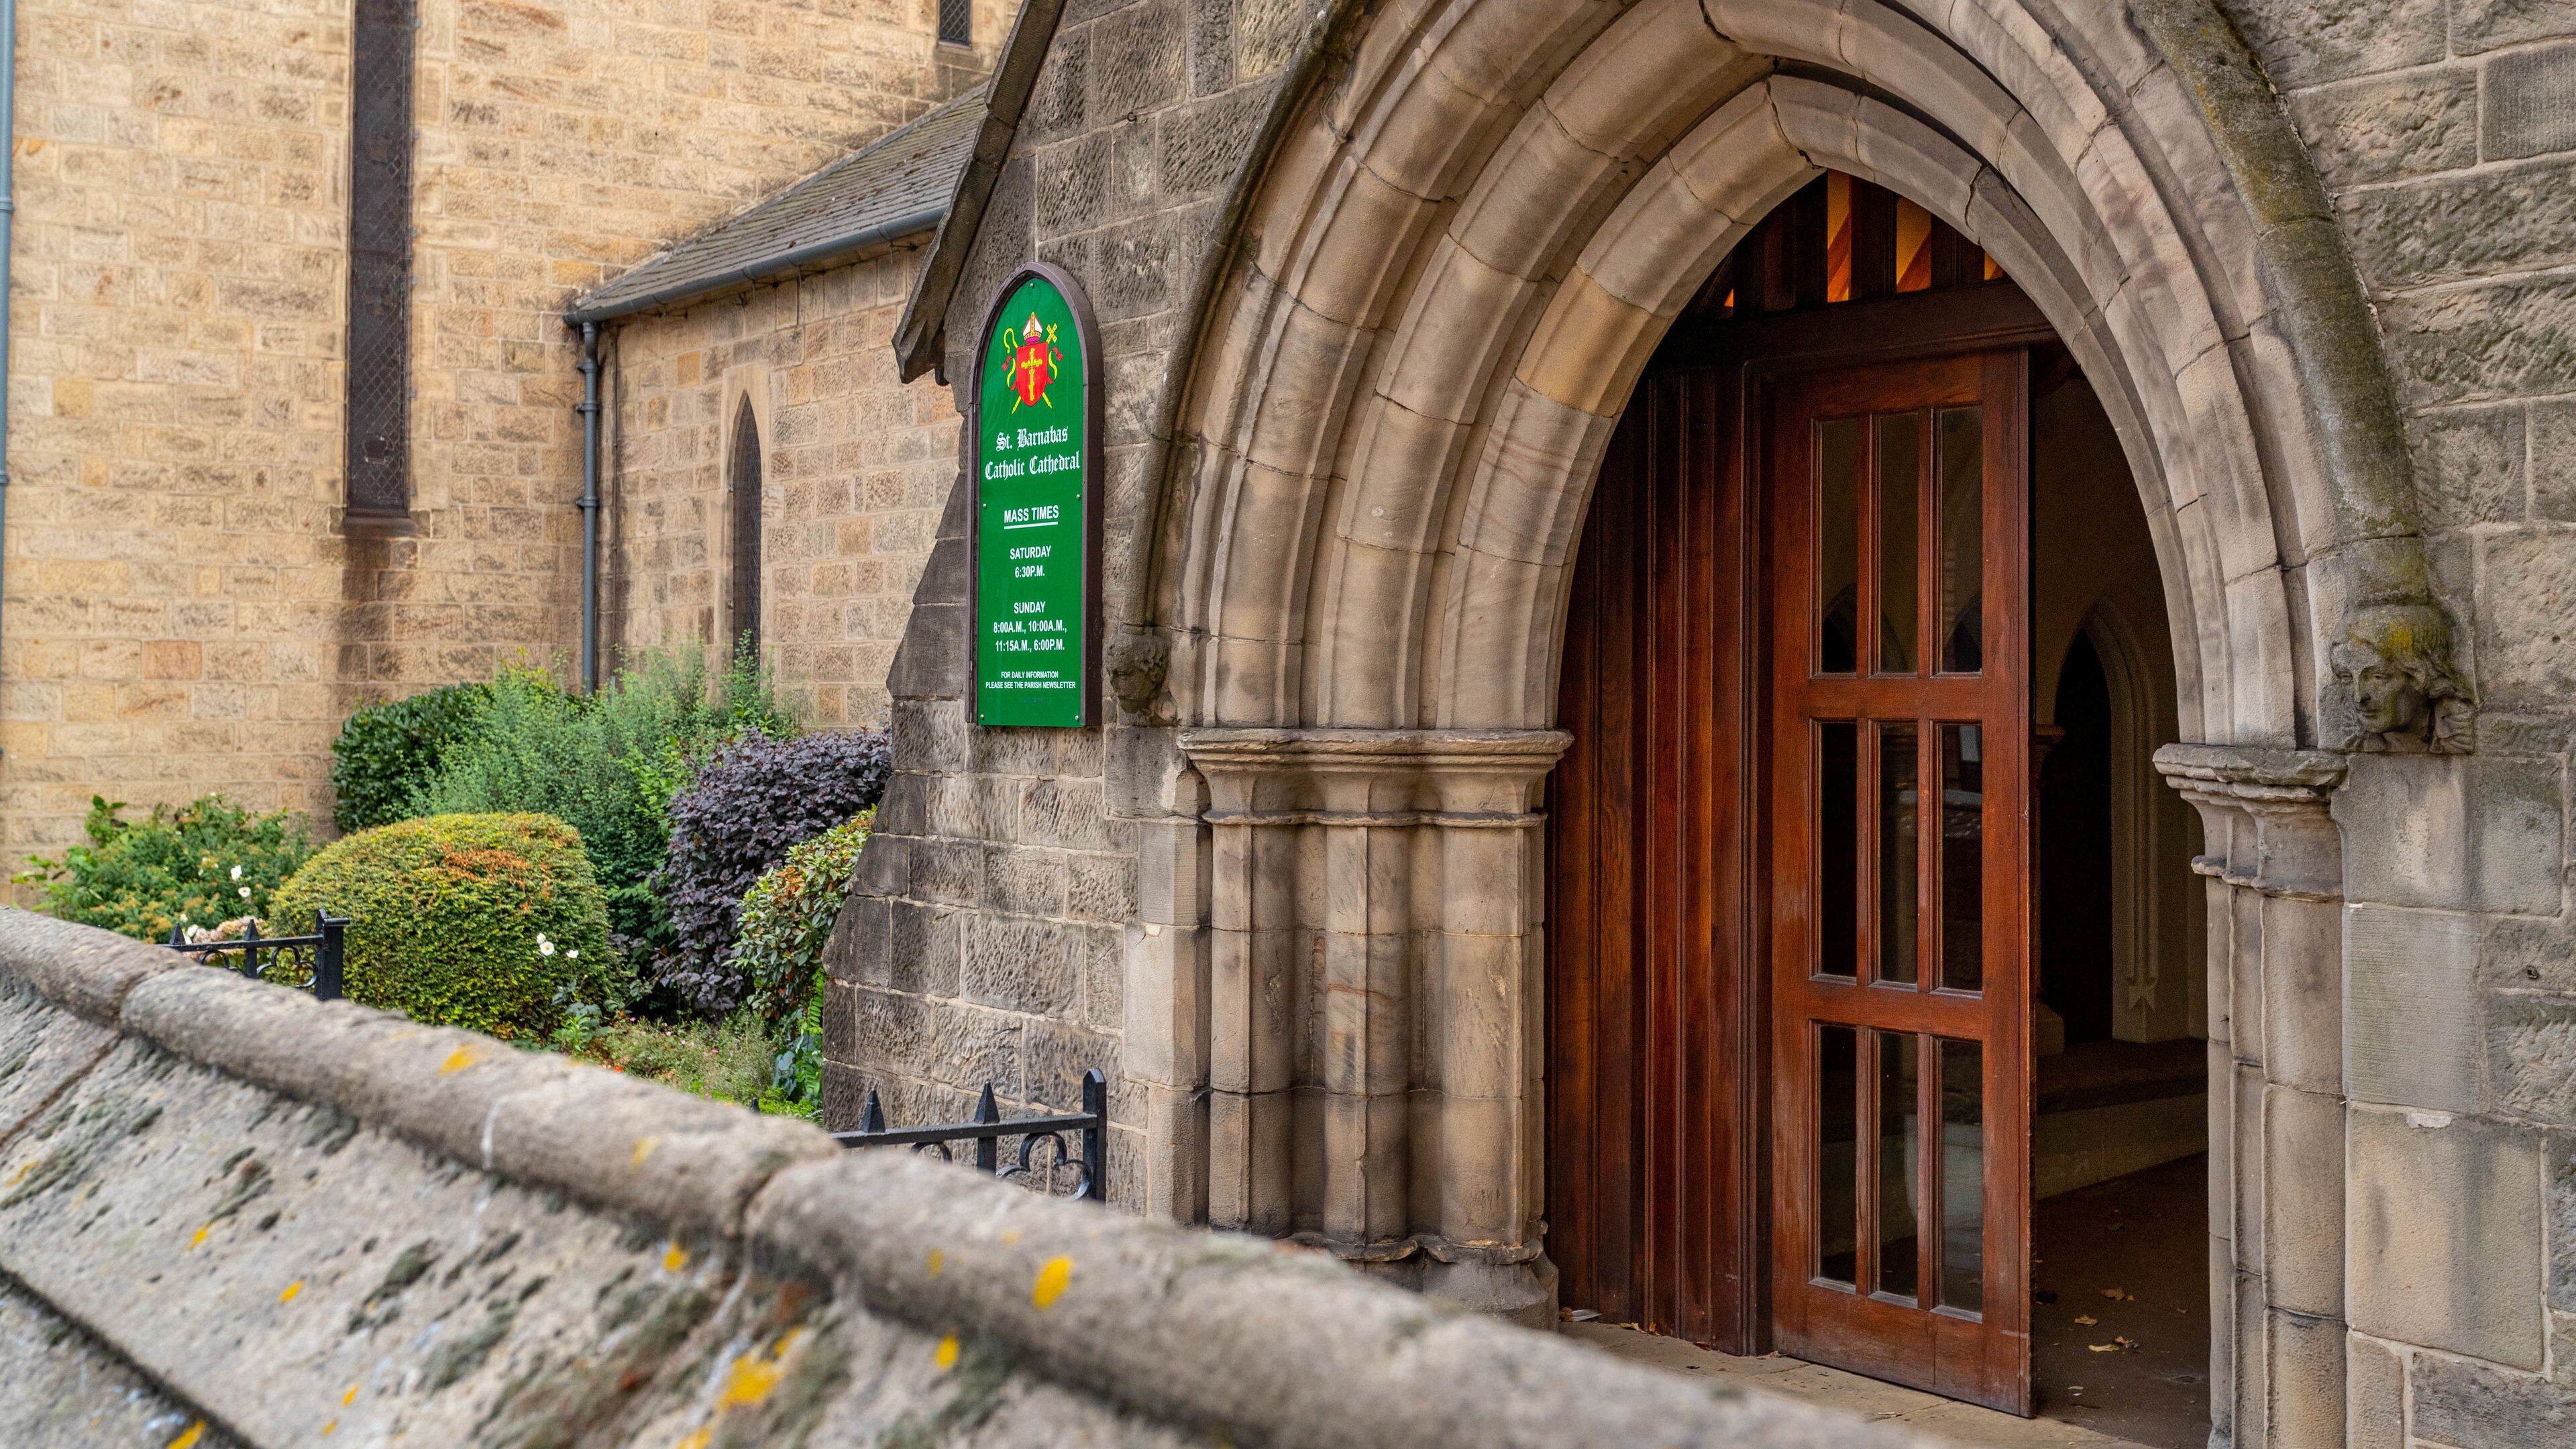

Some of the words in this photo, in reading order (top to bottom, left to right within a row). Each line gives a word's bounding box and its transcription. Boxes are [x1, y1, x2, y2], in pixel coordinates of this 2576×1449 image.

[996, 431, 1013, 451] St.
[1016, 425, 1069, 451] Barnabas
[985, 458, 1025, 480] Catholic
[1029, 450, 1080, 475] Cathedral
[1004, 507, 1029, 523] MASS
[1031, 504, 1059, 521] TIMES
[1010, 545, 1051, 560] SATURDAY
[1015, 564, 1045, 578] 6:30P.M.
[1014, 601, 1046, 614] SUNDAY
[993, 621, 1026, 635] 8:00A.M.,
[1028, 619, 1067, 633] 10:00A.M.,
[995, 639, 1032, 653] 11:15A.M.,
[1034, 638, 1065, 651] 6:00P.M.
[1001, 671, 1011, 679] FOR
[1011, 671, 1025, 679] DAILY
[1026, 671, 1059, 679] INFORMATION
[985, 681, 1004, 689] PLEASE
[1004, 681, 1014, 689] SEE
[1014, 681, 1024, 689] THE
[1024, 681, 1042, 689] PARISH
[1042, 681, 1076, 689] NEWSLETTER
